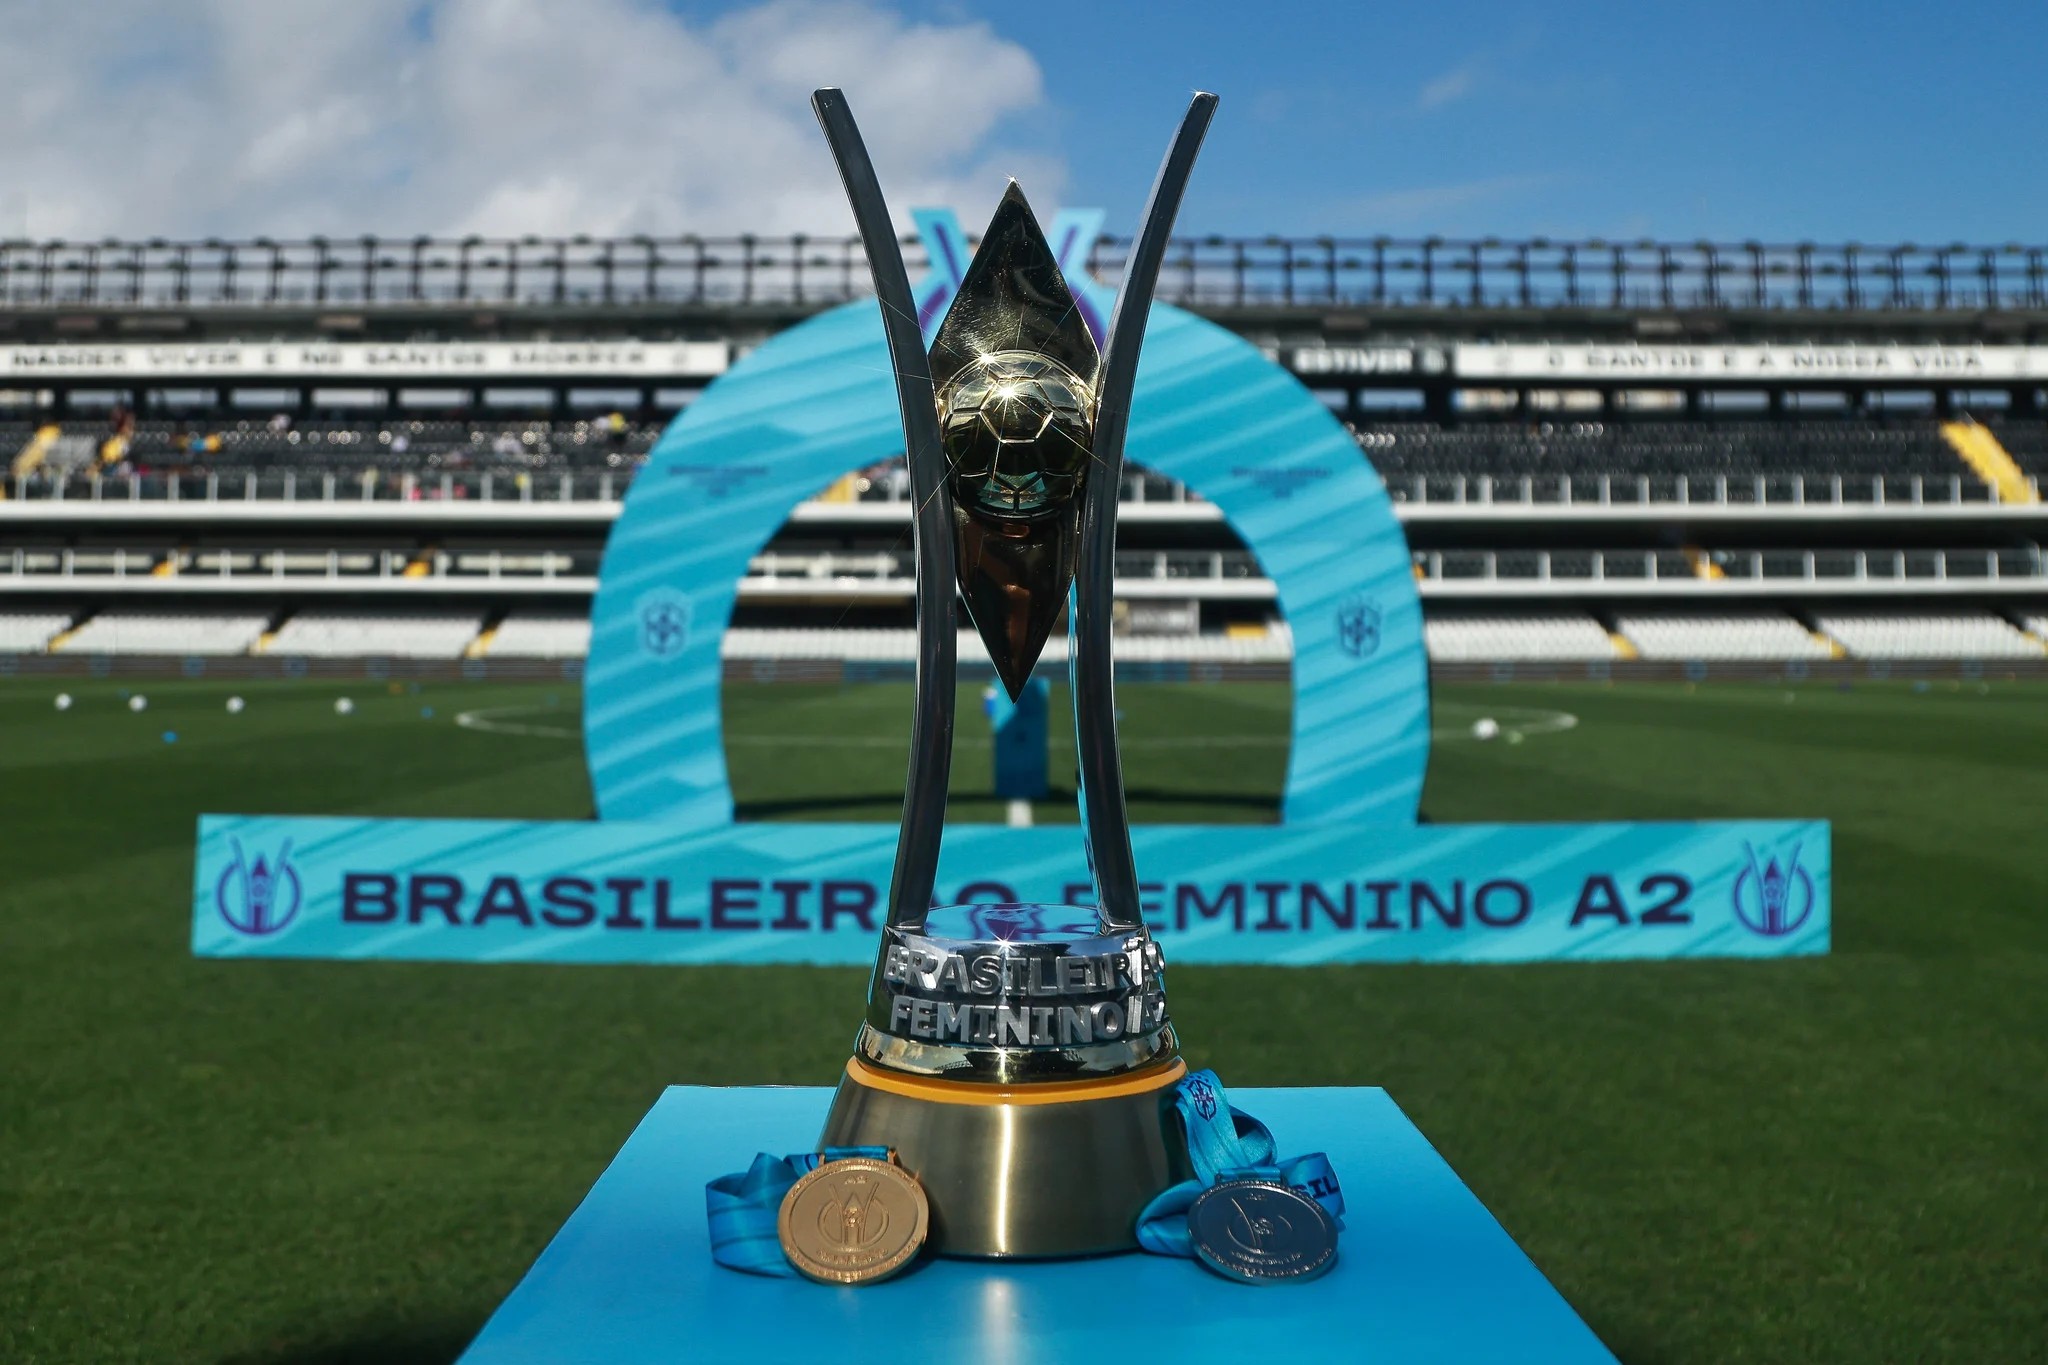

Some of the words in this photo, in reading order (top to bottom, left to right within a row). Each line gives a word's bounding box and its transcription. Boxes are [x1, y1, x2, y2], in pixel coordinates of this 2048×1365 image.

[1586, 348, 1701, 369] SANTOS
[339, 871, 1022, 932] BRASILEIRO
[1569, 873, 1693, 927] A2
[889, 994, 1125, 1046] FEMININO
